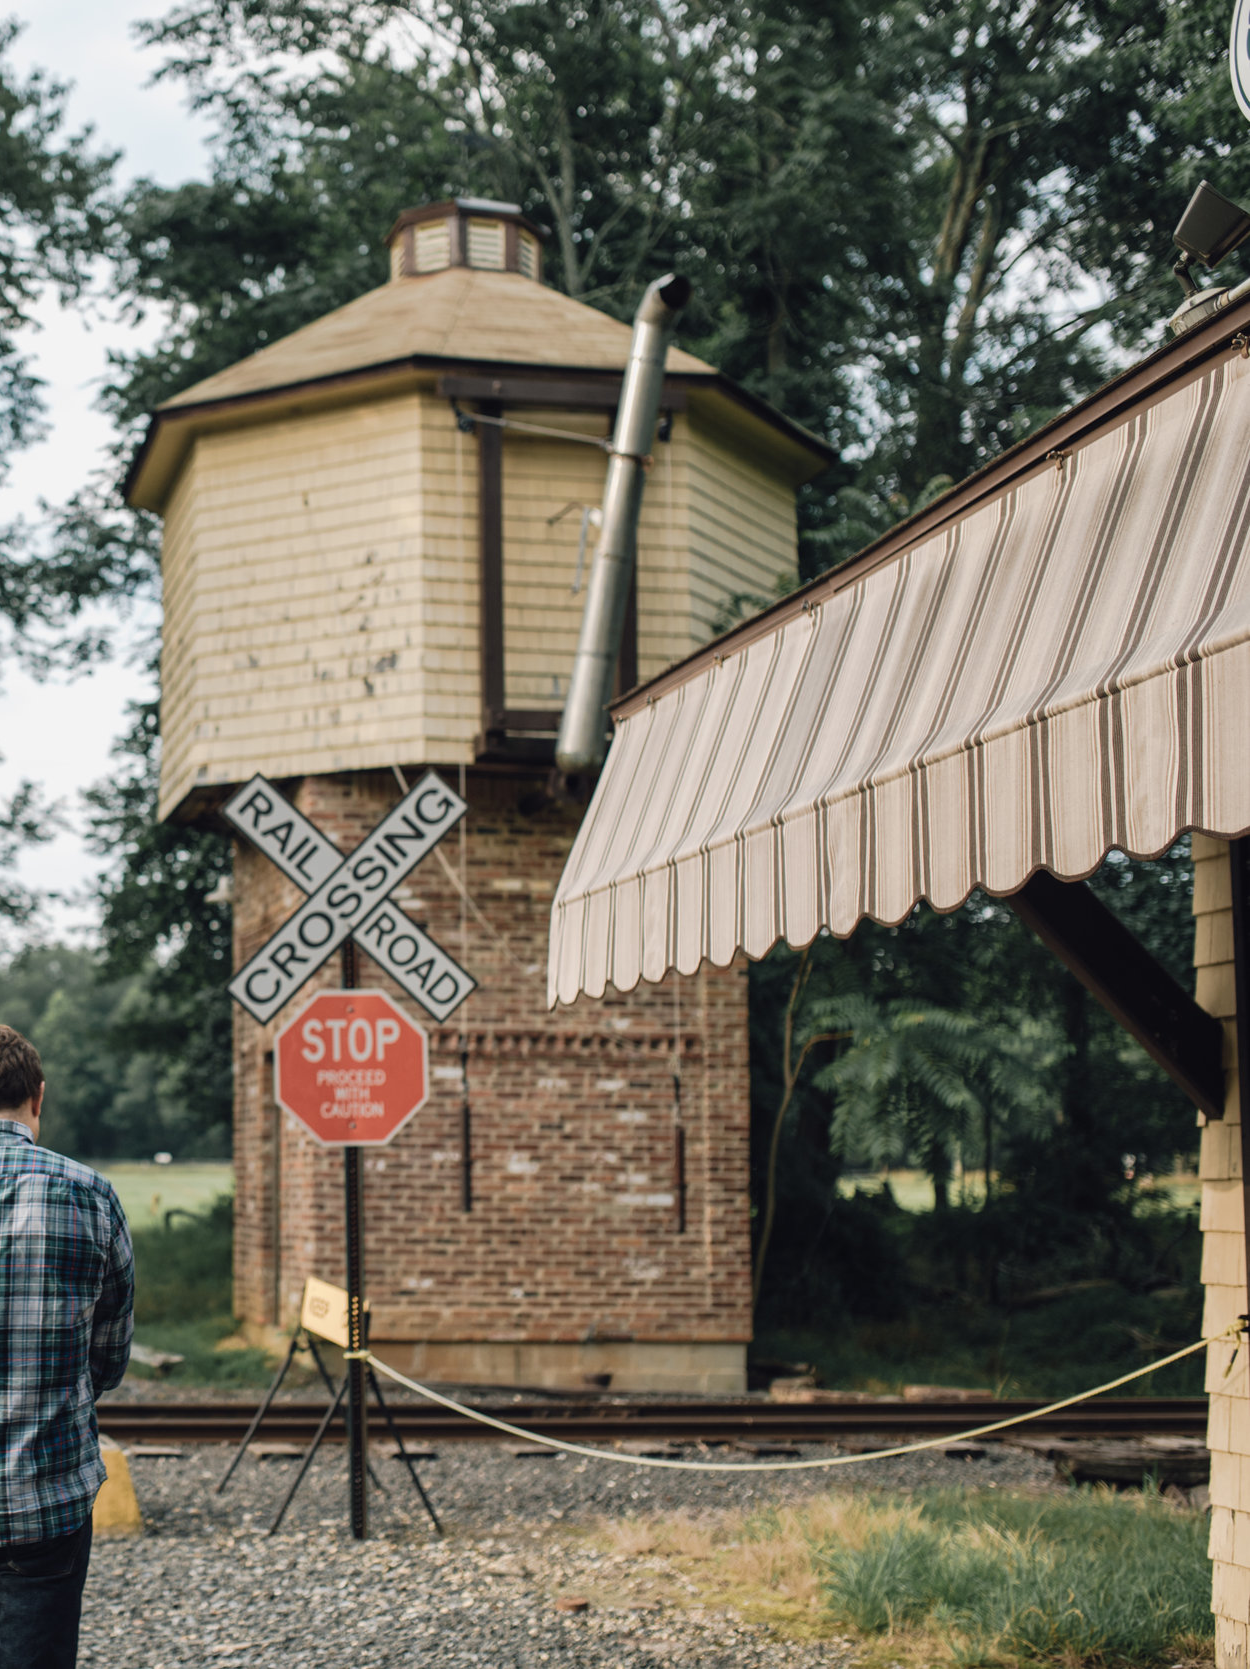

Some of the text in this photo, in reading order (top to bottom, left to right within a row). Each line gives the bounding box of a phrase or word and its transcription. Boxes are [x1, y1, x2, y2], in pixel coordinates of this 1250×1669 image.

[239, 791, 460, 1005] RAIL ROAD
[245, 789, 455, 1004] CROSSING
[301, 1018, 401, 1063] STOP
[316, 1069, 386, 1087] PROCEED
[334, 1087, 370, 1101] WITH
[320, 1102, 385, 1119] CAUTION
